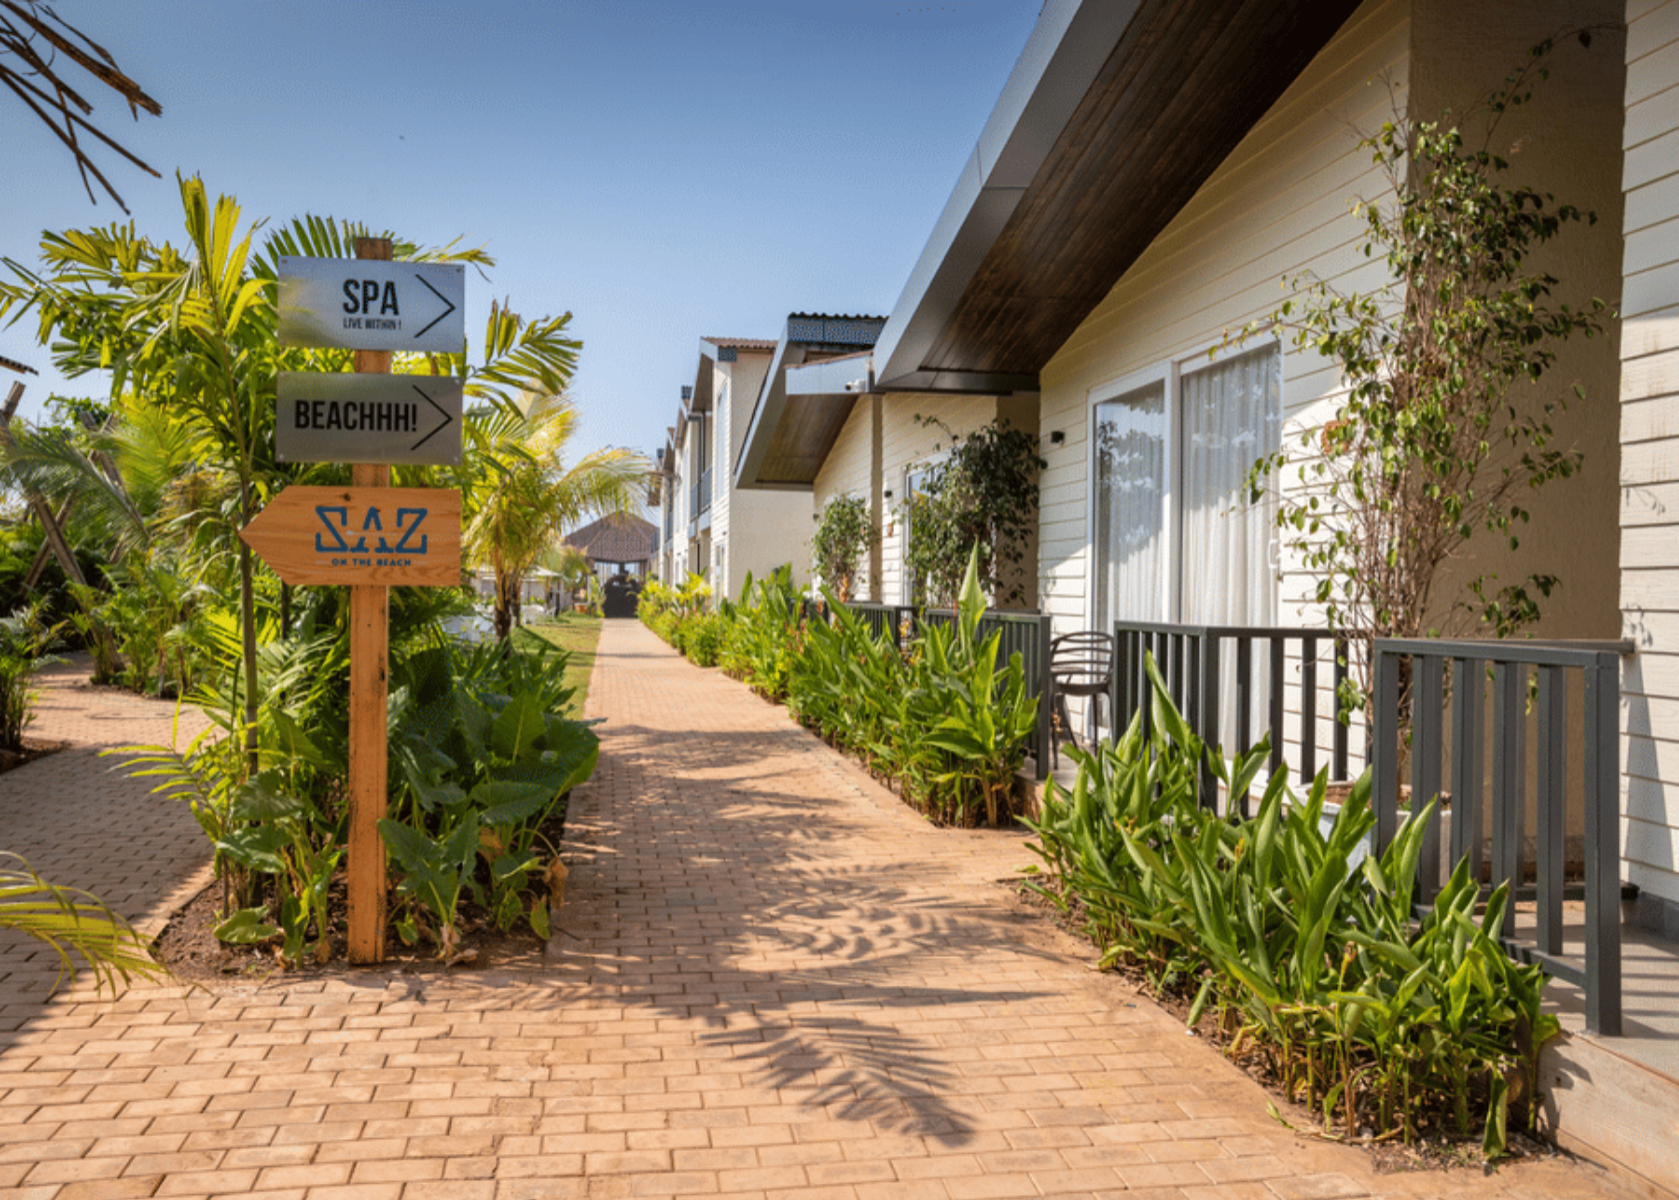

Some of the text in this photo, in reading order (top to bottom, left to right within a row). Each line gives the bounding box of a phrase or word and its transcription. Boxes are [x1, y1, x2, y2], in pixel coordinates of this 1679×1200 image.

[342, 278, 399, 316] SPA
[342, 317, 363, 330] LIVE
[365, 318, 396, 331] WITHIN
[293, 399, 418, 433] BEACHHH!
[331, 558, 412, 567] ON THE BEACH
